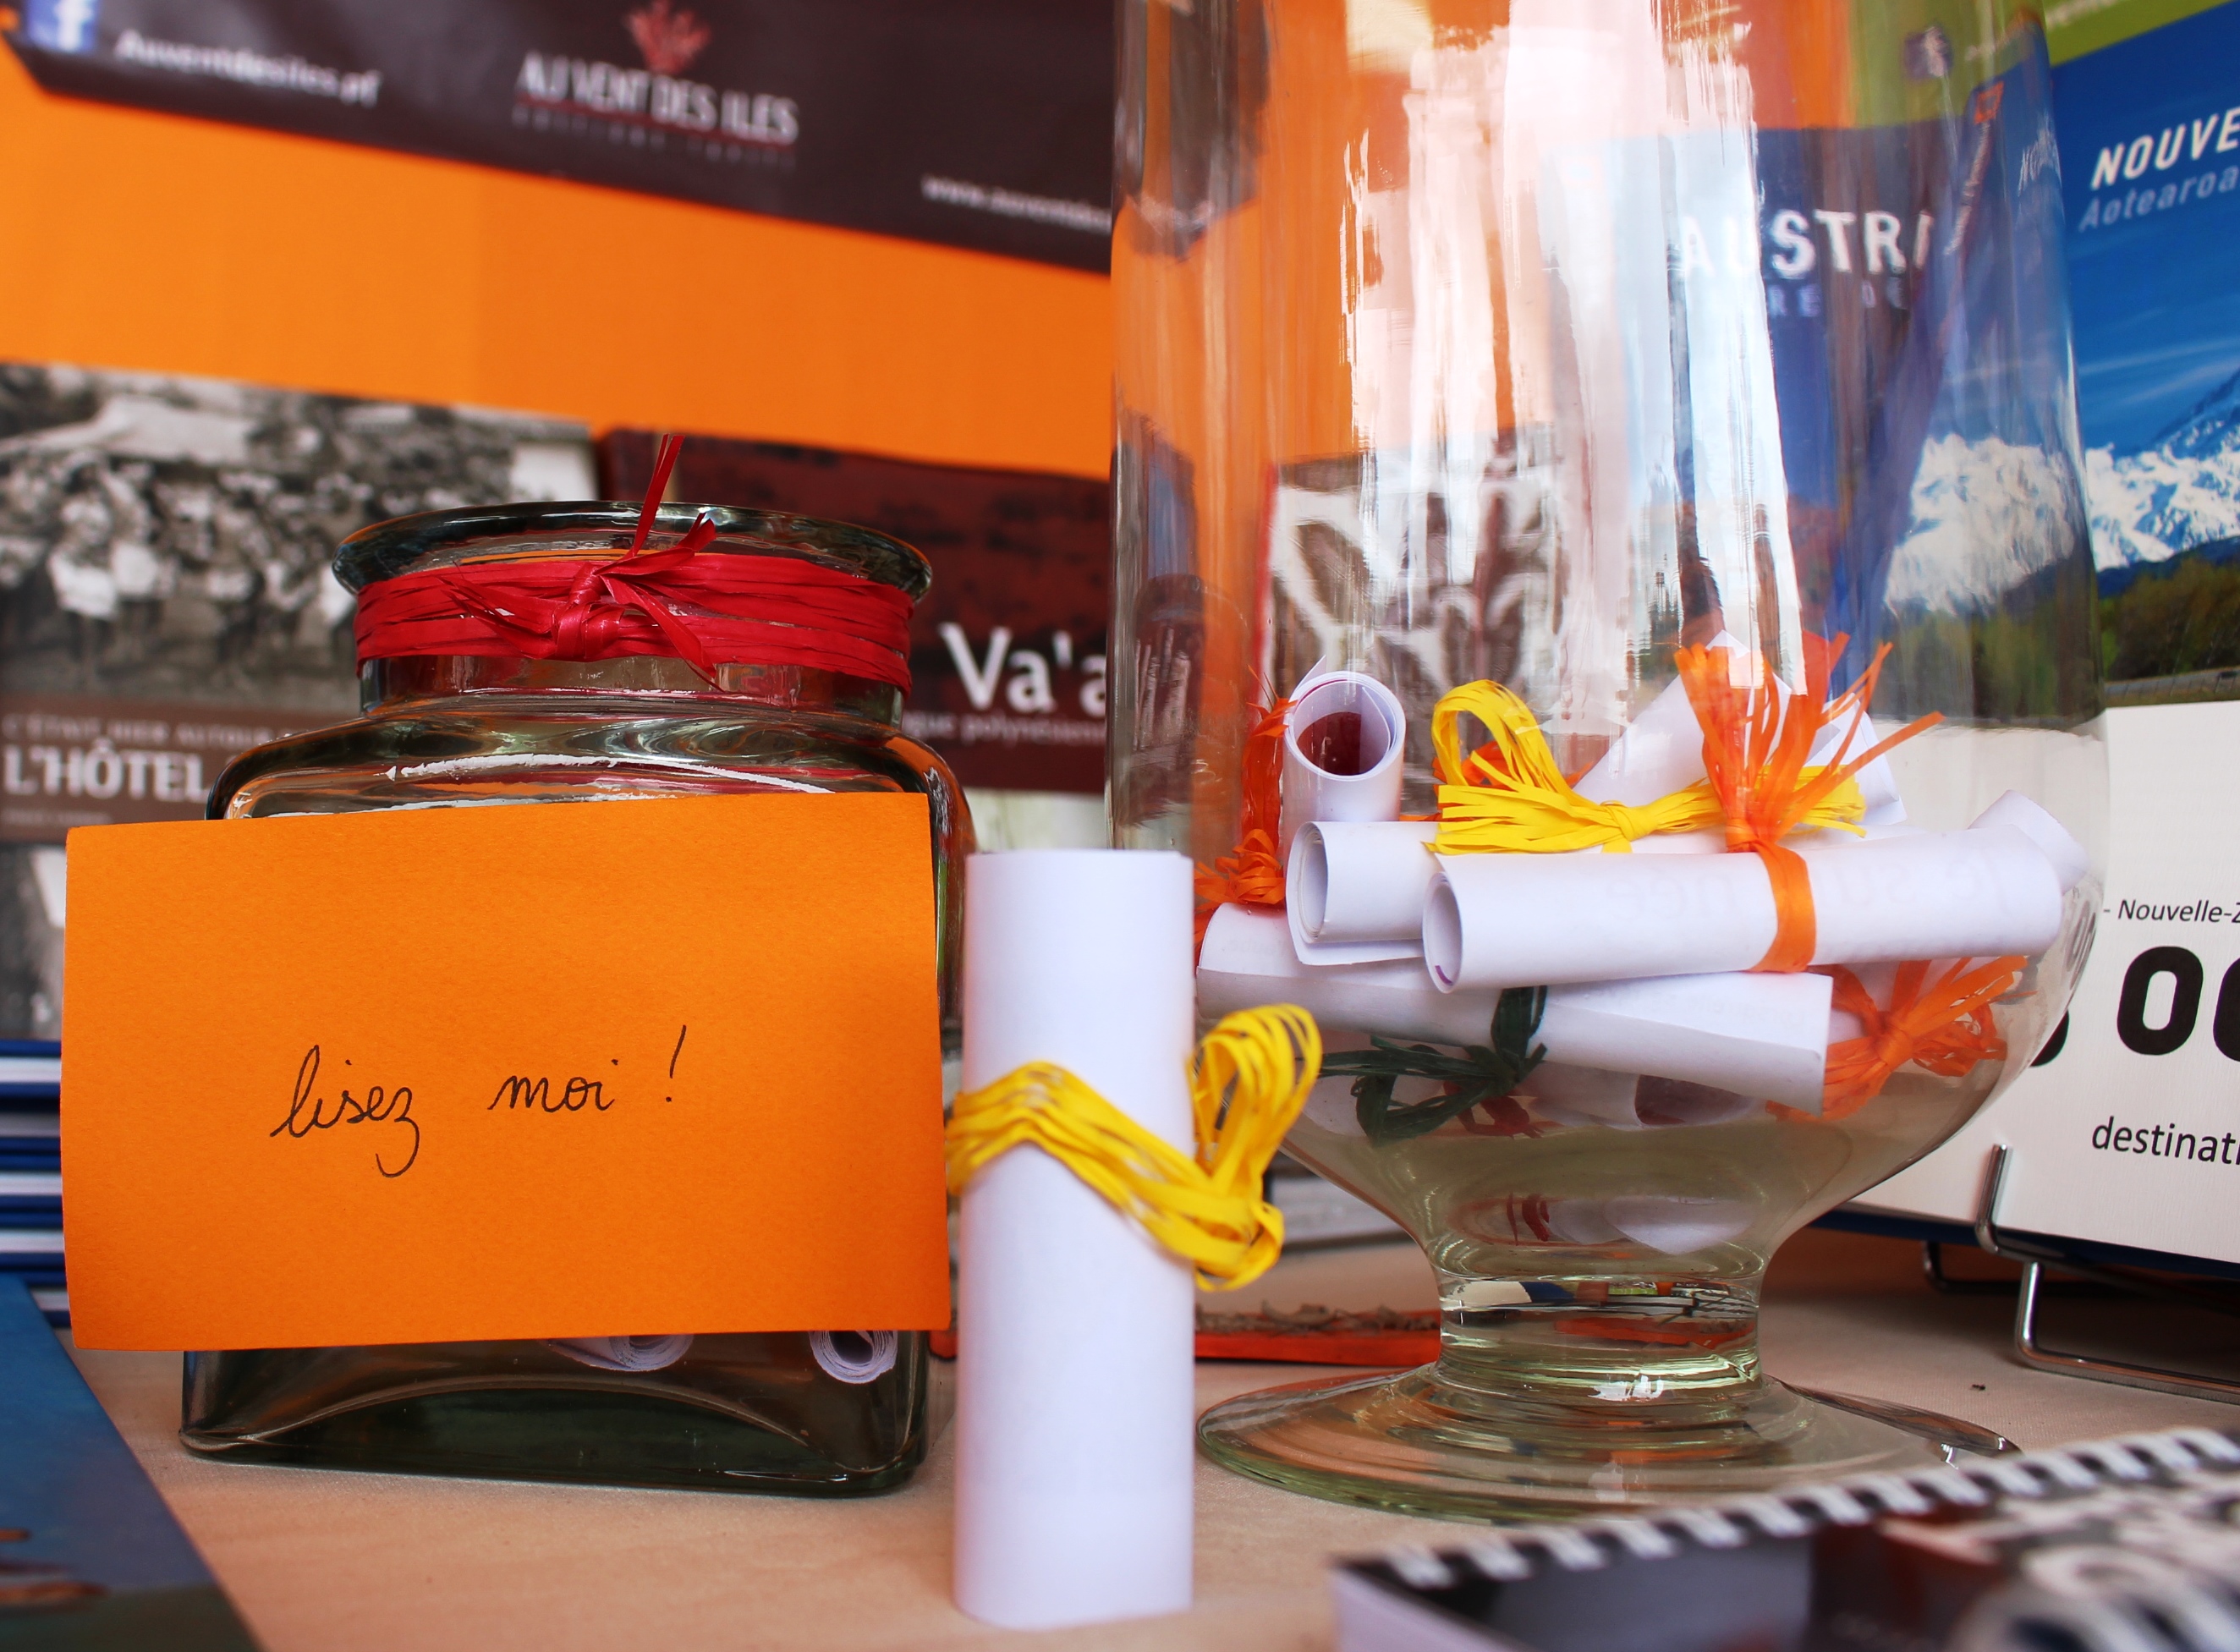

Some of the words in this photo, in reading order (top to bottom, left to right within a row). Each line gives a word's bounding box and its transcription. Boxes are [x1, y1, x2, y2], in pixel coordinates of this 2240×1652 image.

[514, 51, 568, 102] AU
[571, 58, 650, 113] VENT
[651, 74, 717, 132] DES
[722, 90, 799, 145] ILES
[2090, 107, 2240, 190] NOUVE
[2078, 165, 2239, 233] Aotearoa
[939, 622, 1106, 717] Va'a
[3, 736, 211, 803] L'HÔTEL
[270, 1044, 420, 1178] lisez
[487, 1058, 618, 1113] moi
[664, 1024, 687, 1103] !
